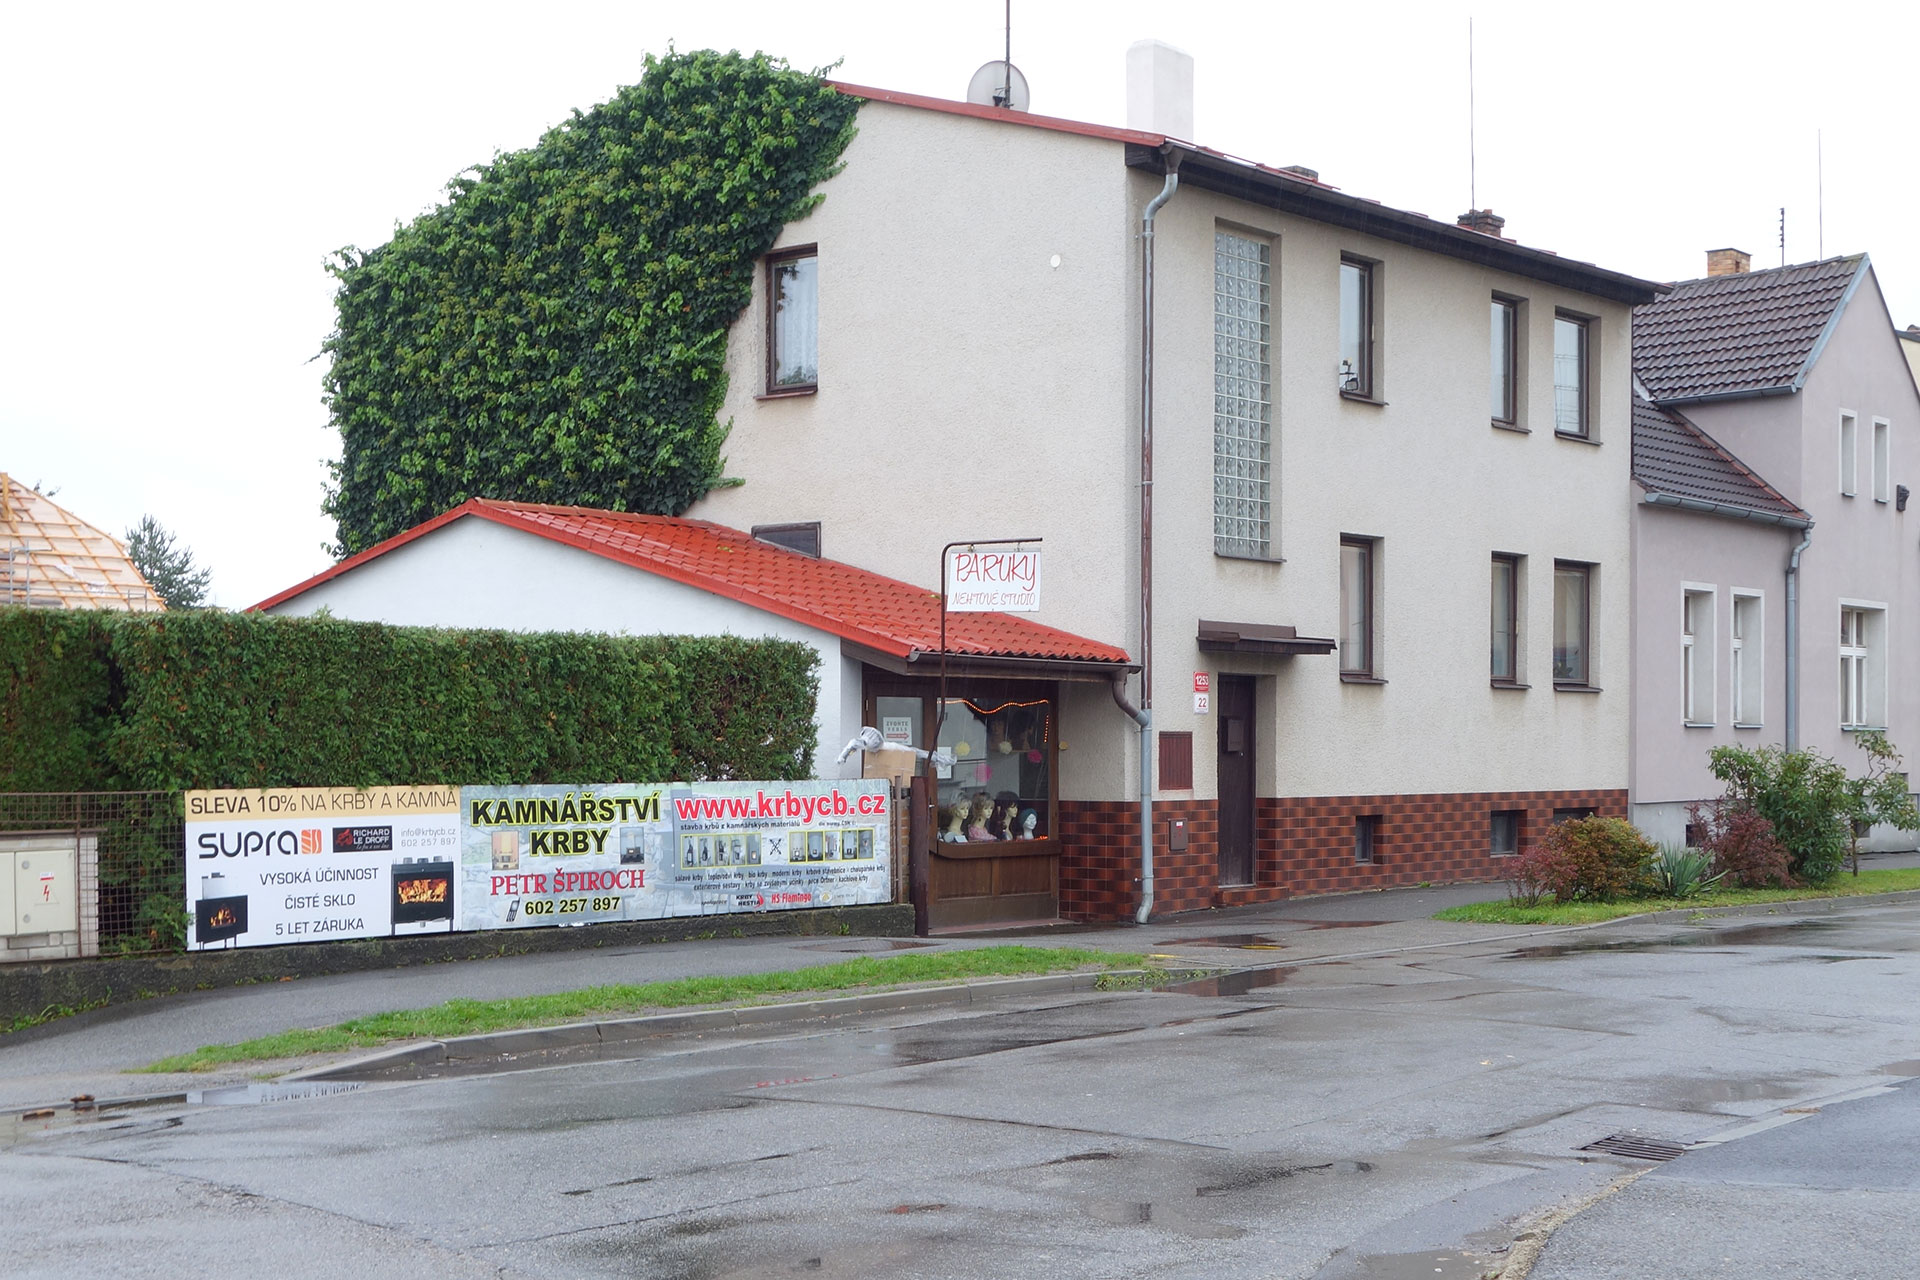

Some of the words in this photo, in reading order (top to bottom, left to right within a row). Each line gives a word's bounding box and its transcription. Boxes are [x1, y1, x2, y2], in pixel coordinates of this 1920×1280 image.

[955, 553, 1037, 592] PARUKY
[1001, 592, 1035, 606] STUDIO
[1195, 675, 1209, 686] 1253
[1198, 697, 1207, 708] 22
[191, 796, 251, 814] SLEVA
[257, 794, 297, 813] 10%
[302, 794, 327, 811] NA
[331, 792, 376, 810] KRBY
[381, 792, 392, 808] A
[397, 791, 457, 808] KAMNA
[471, 791, 661, 826] KAMNÁŘSTVÍ
[675, 789, 886, 823] www.krbycb.cz
[704, 821, 720, 829] krbů
[353, 828, 390, 837] RICHARD
[401, 828, 456, 838] info@krbycb.cz
[365, 836, 389, 844] DROFF
[401, 839, 417, 848] 602
[421, 838, 437, 847] 257
[440, 837, 457, 846] 897
[530, 827, 611, 857] KRBY
[259, 867, 312, 886] VYSOKÁ
[315, 866, 379, 883] ÚČINNOST
[490, 873, 547, 896] PETR
[553, 867, 645, 894] ŠPIROCH
[692, 874, 703, 882] krby
[734, 872, 744, 880] krby
[757, 871, 768, 879] krby
[792, 869, 802, 877] krby
[745, 881, 755, 889] krby
[284, 893, 319, 909] ČISTÉ
[323, 893, 355, 907] SKLO
[771, 893, 780, 904] HS
[782, 892, 812, 904] Flamingo
[525, 900, 554, 915] 602
[559, 898, 588, 913] 257
[592, 897, 621, 912] 897
[275, 923, 283, 935] 5
[288, 921, 309, 935] LET
[313, 917, 365, 933] ZÁRUKA
